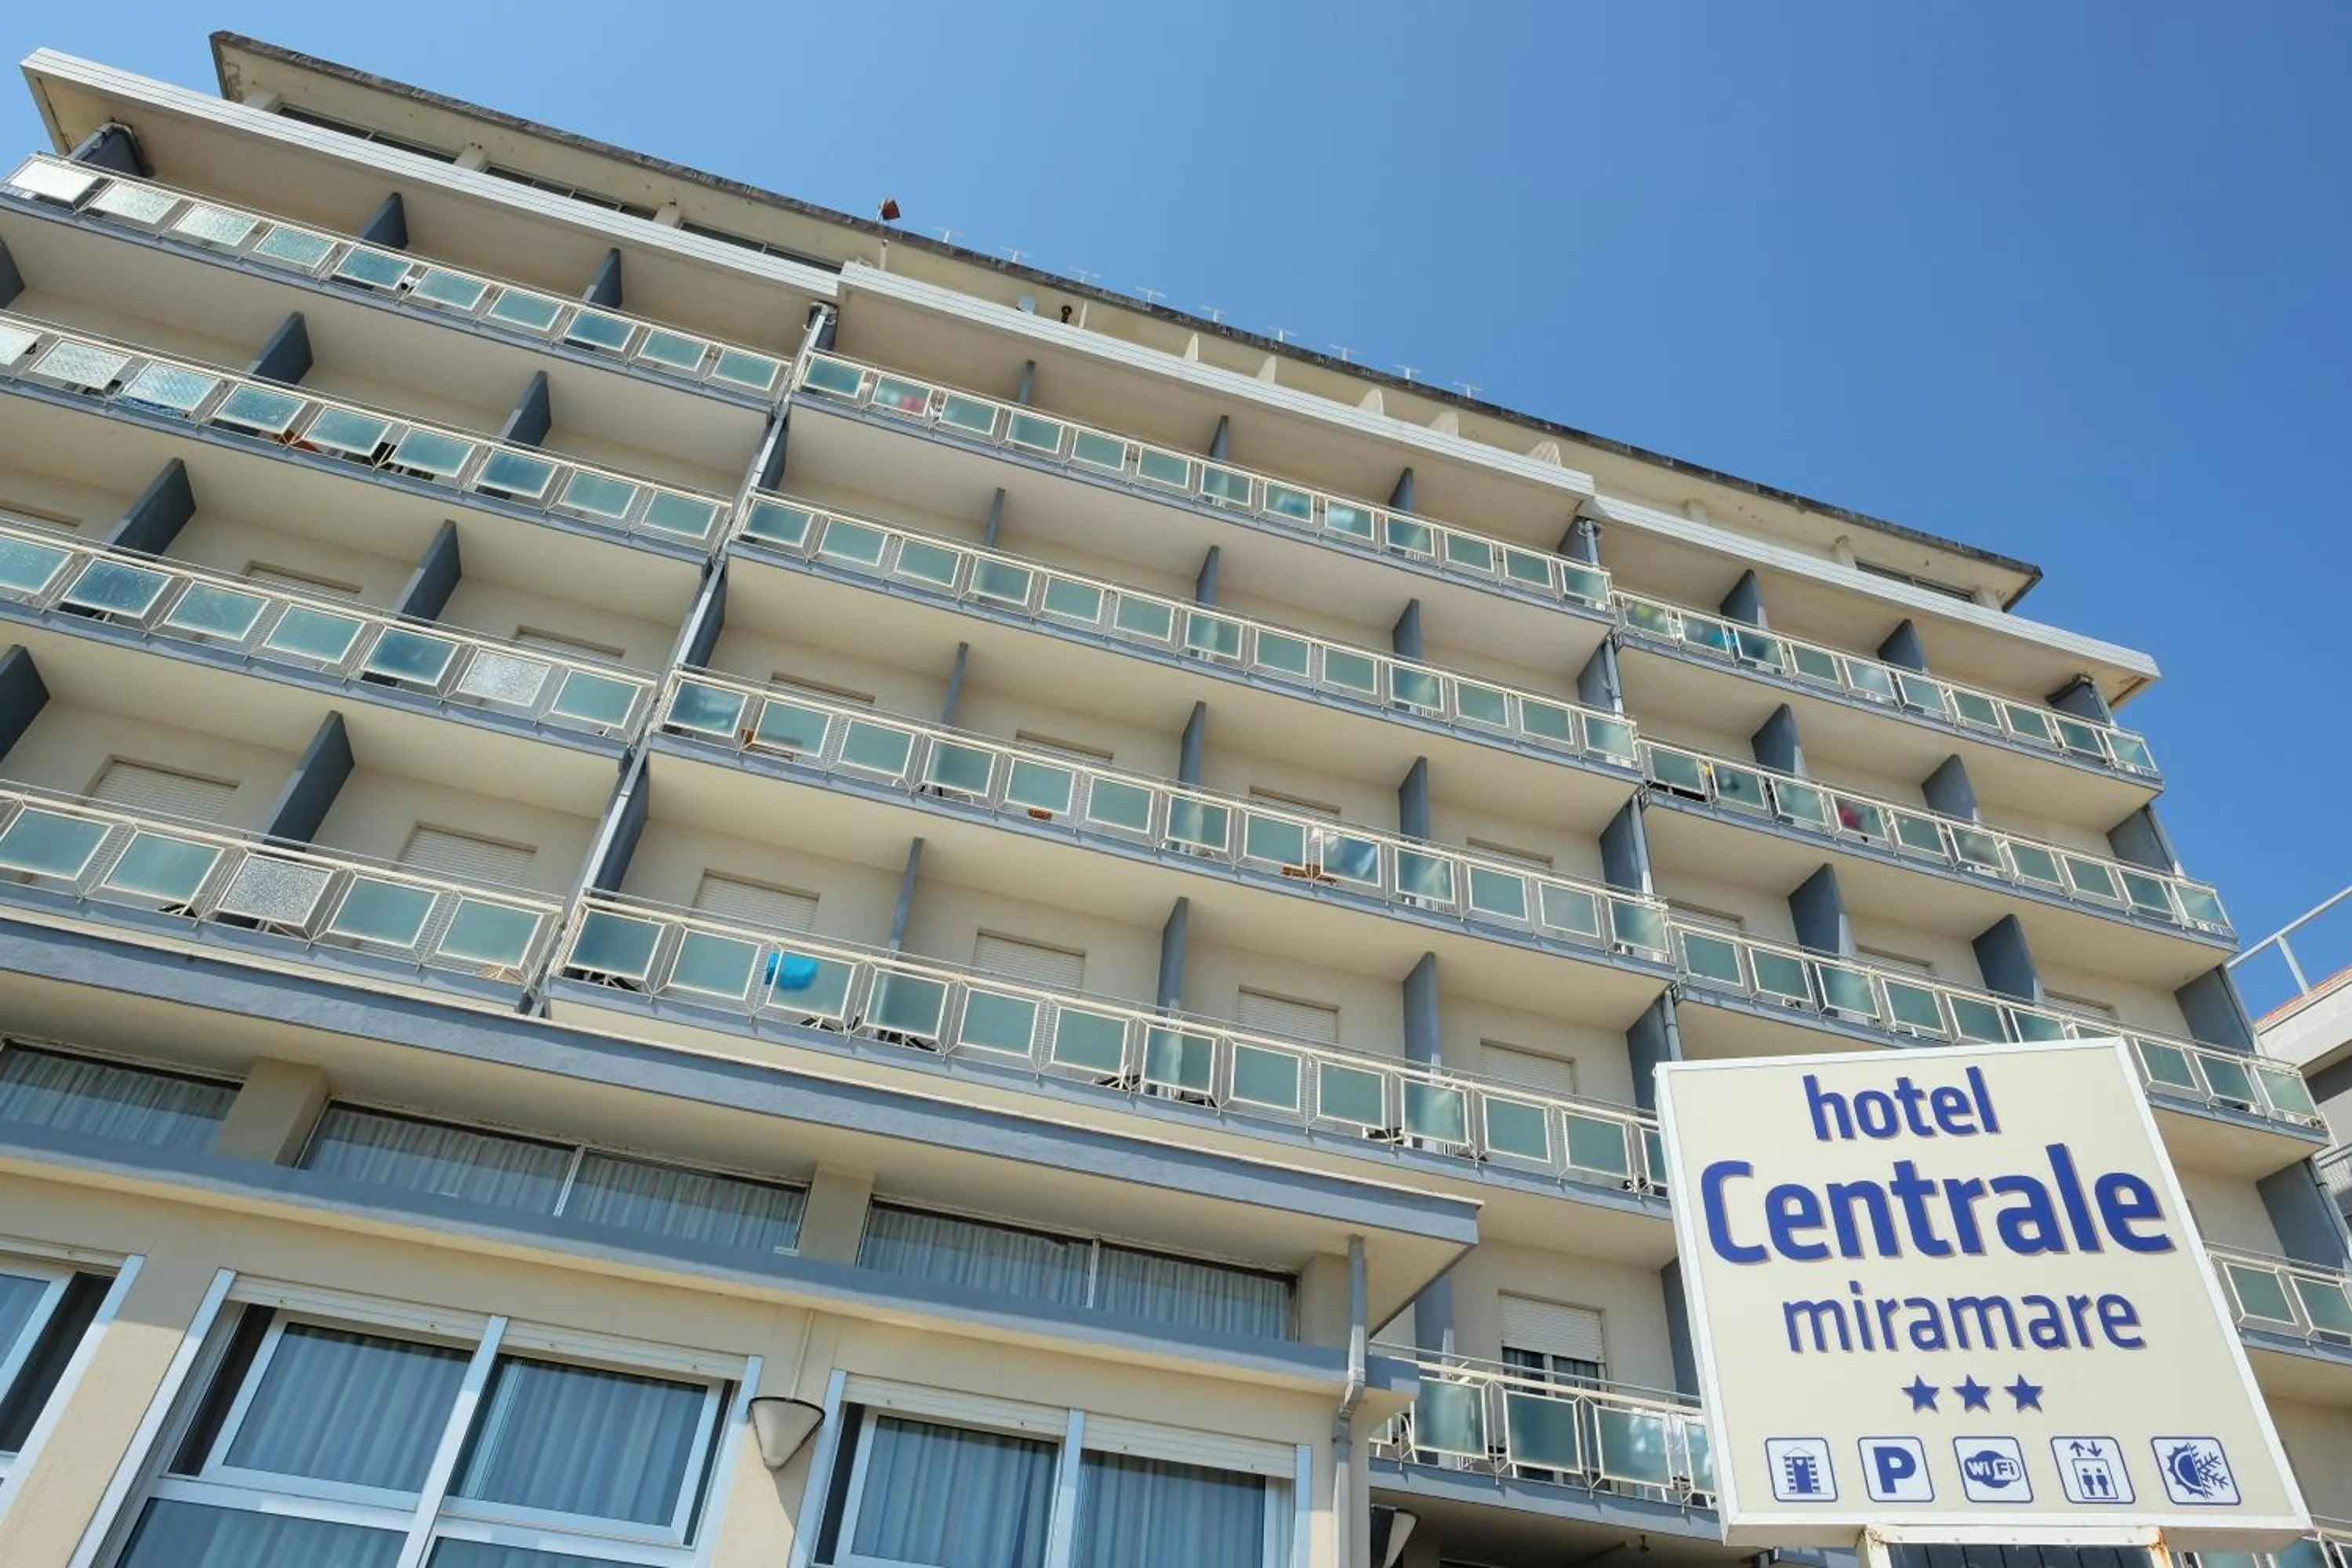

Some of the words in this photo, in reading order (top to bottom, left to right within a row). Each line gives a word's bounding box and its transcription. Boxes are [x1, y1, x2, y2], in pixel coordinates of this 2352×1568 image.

[1803, 1066, 1998, 1141] hotel
[1700, 1142, 2174, 1264] Centrale
[1783, 1279, 2144, 1352] miramare
[1873, 1446, 1917, 1494] P
